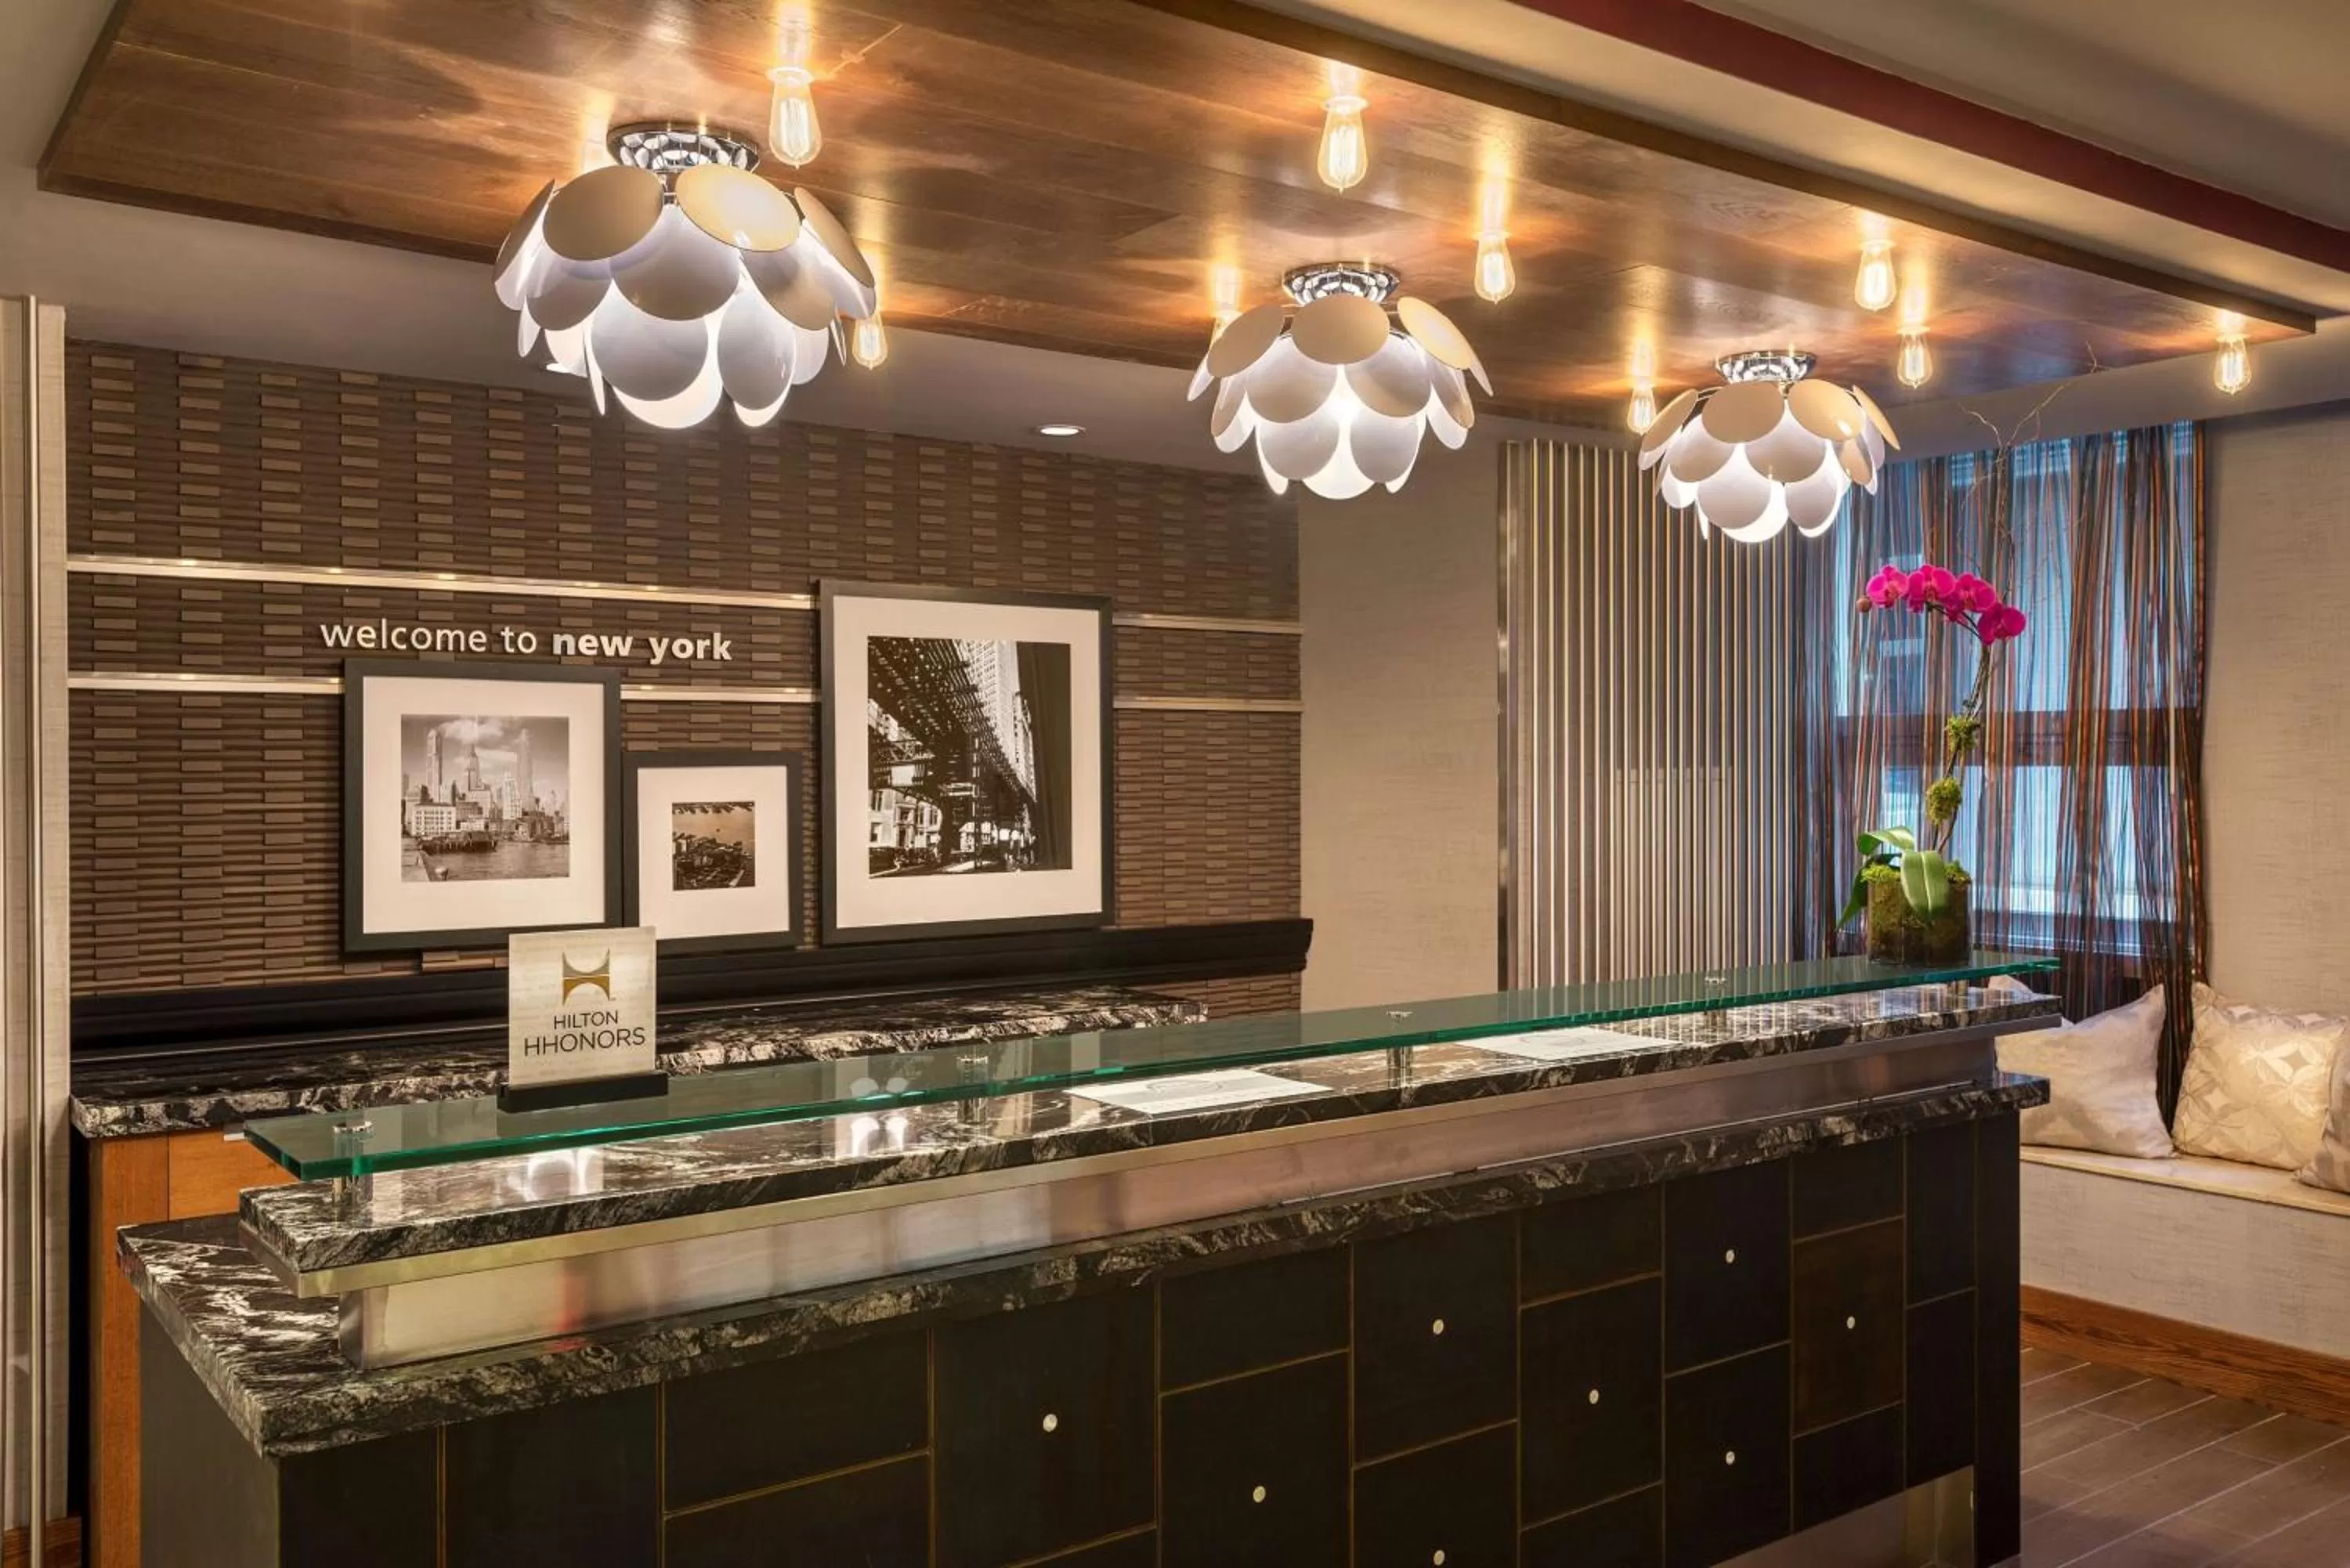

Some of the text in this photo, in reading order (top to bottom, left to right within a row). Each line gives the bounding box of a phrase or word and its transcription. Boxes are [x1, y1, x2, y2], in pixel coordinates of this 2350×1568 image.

[320, 617, 732, 665] welcome to new york
[553, 1010, 619, 1030] HILTON
[523, 1027, 646, 1057] HHONORS
